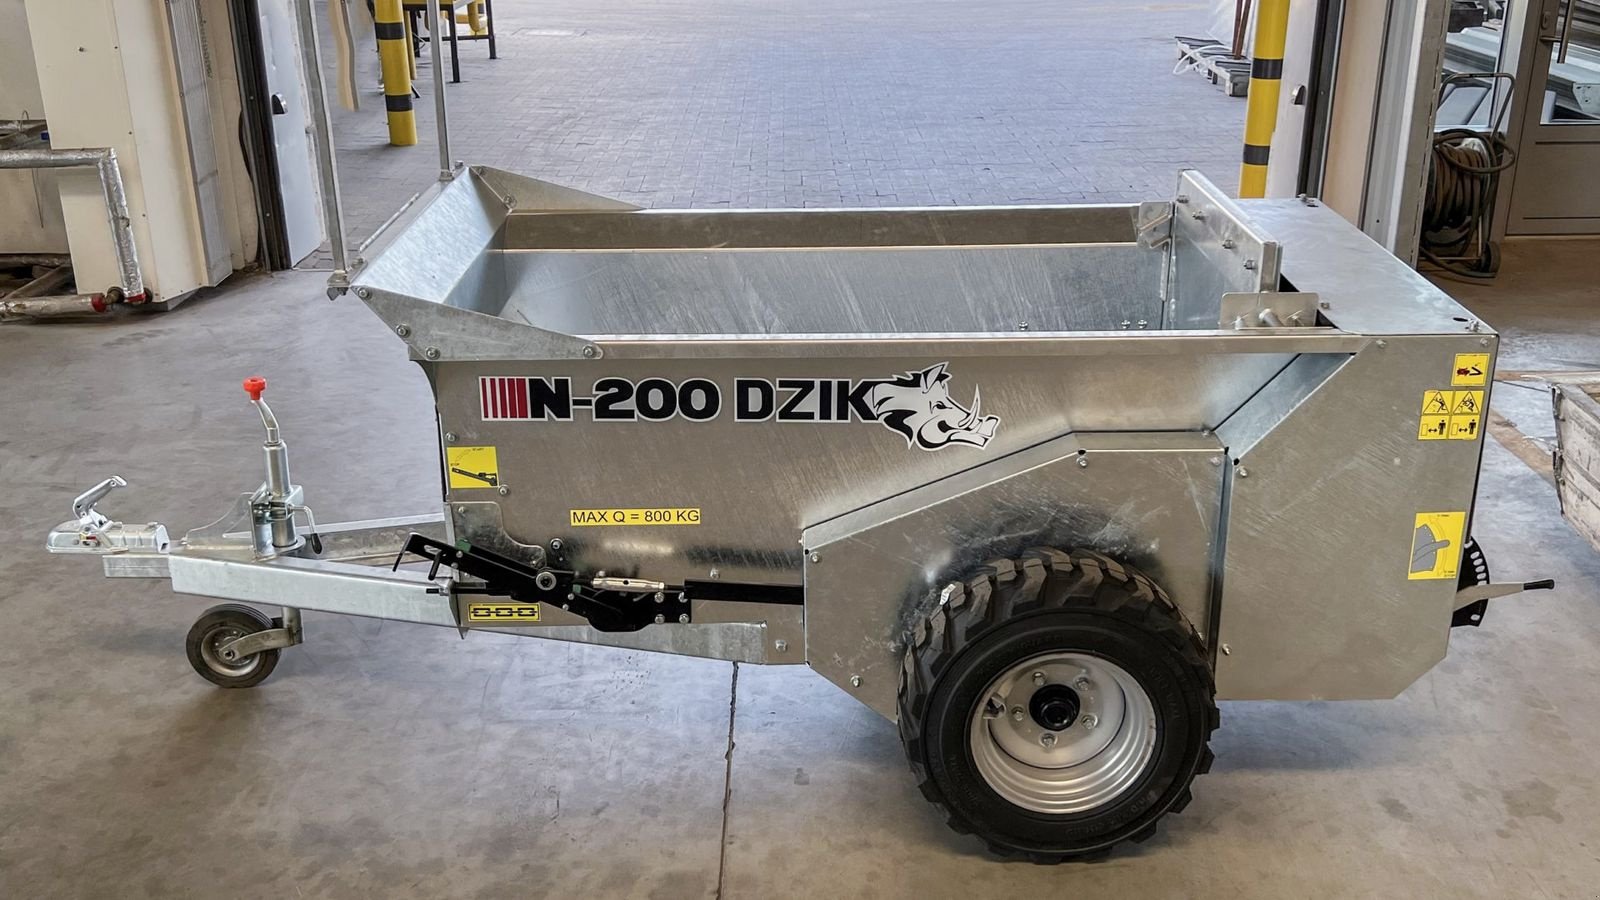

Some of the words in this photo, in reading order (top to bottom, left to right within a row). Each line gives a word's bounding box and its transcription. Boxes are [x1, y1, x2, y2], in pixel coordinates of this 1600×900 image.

[528, 377, 721, 421] N-200
[735, 379, 879, 422] DZIK
[573, 511, 608, 523] MAX
[613, 511, 625, 523] Q
[644, 510, 671, 522] 800
[677, 509, 699, 522] KG
